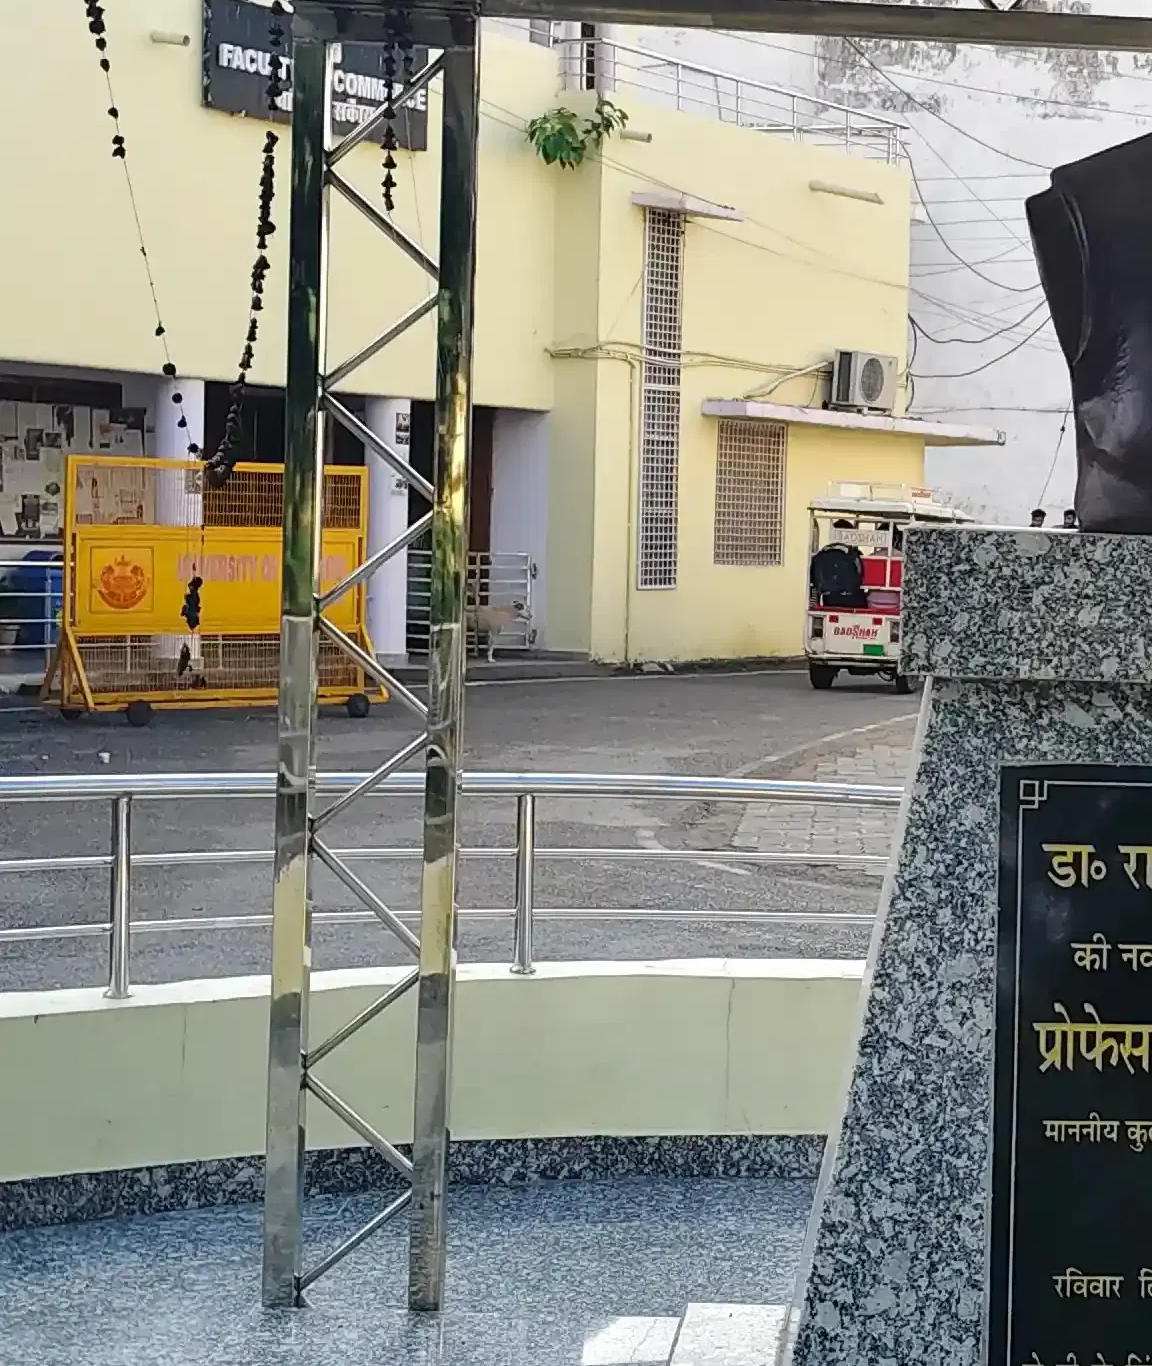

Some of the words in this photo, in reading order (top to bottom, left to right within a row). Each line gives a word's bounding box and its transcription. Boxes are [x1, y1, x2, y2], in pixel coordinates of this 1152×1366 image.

[219, 43, 293, 80] FACUT
[834, 625, 879, 638] BADSHAH
[1071, 934, 1111, 970] की
[1043, 1113, 1119, 1141] माननीय
[1053, 1268, 1124, 1297] रविवार
